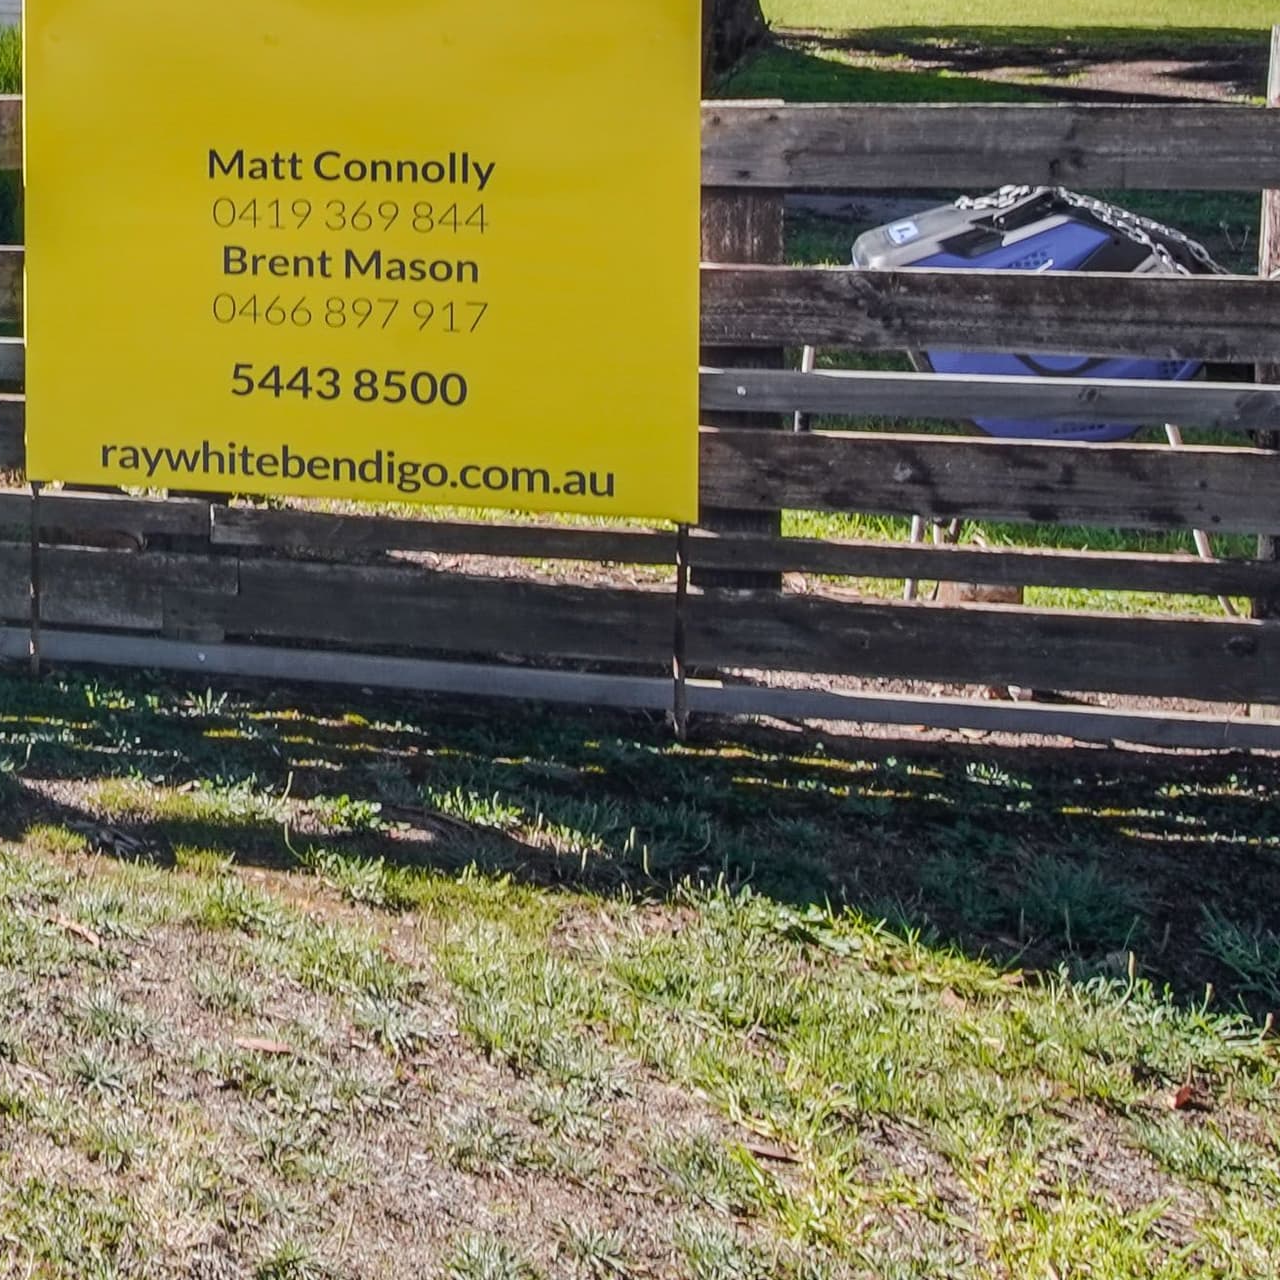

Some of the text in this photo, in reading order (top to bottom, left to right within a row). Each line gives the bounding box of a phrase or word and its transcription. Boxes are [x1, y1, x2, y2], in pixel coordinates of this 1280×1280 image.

[208, 148, 497, 193] Matt Connolly
[212, 197, 490, 235] 0419 369 844
[223, 244, 480, 285] Brent Mason
[212, 293, 490, 334] 0466 897 917
[230, 362, 469, 408] 5443 8500
[100, 439, 616, 499] raywhitebendigo.com.au
